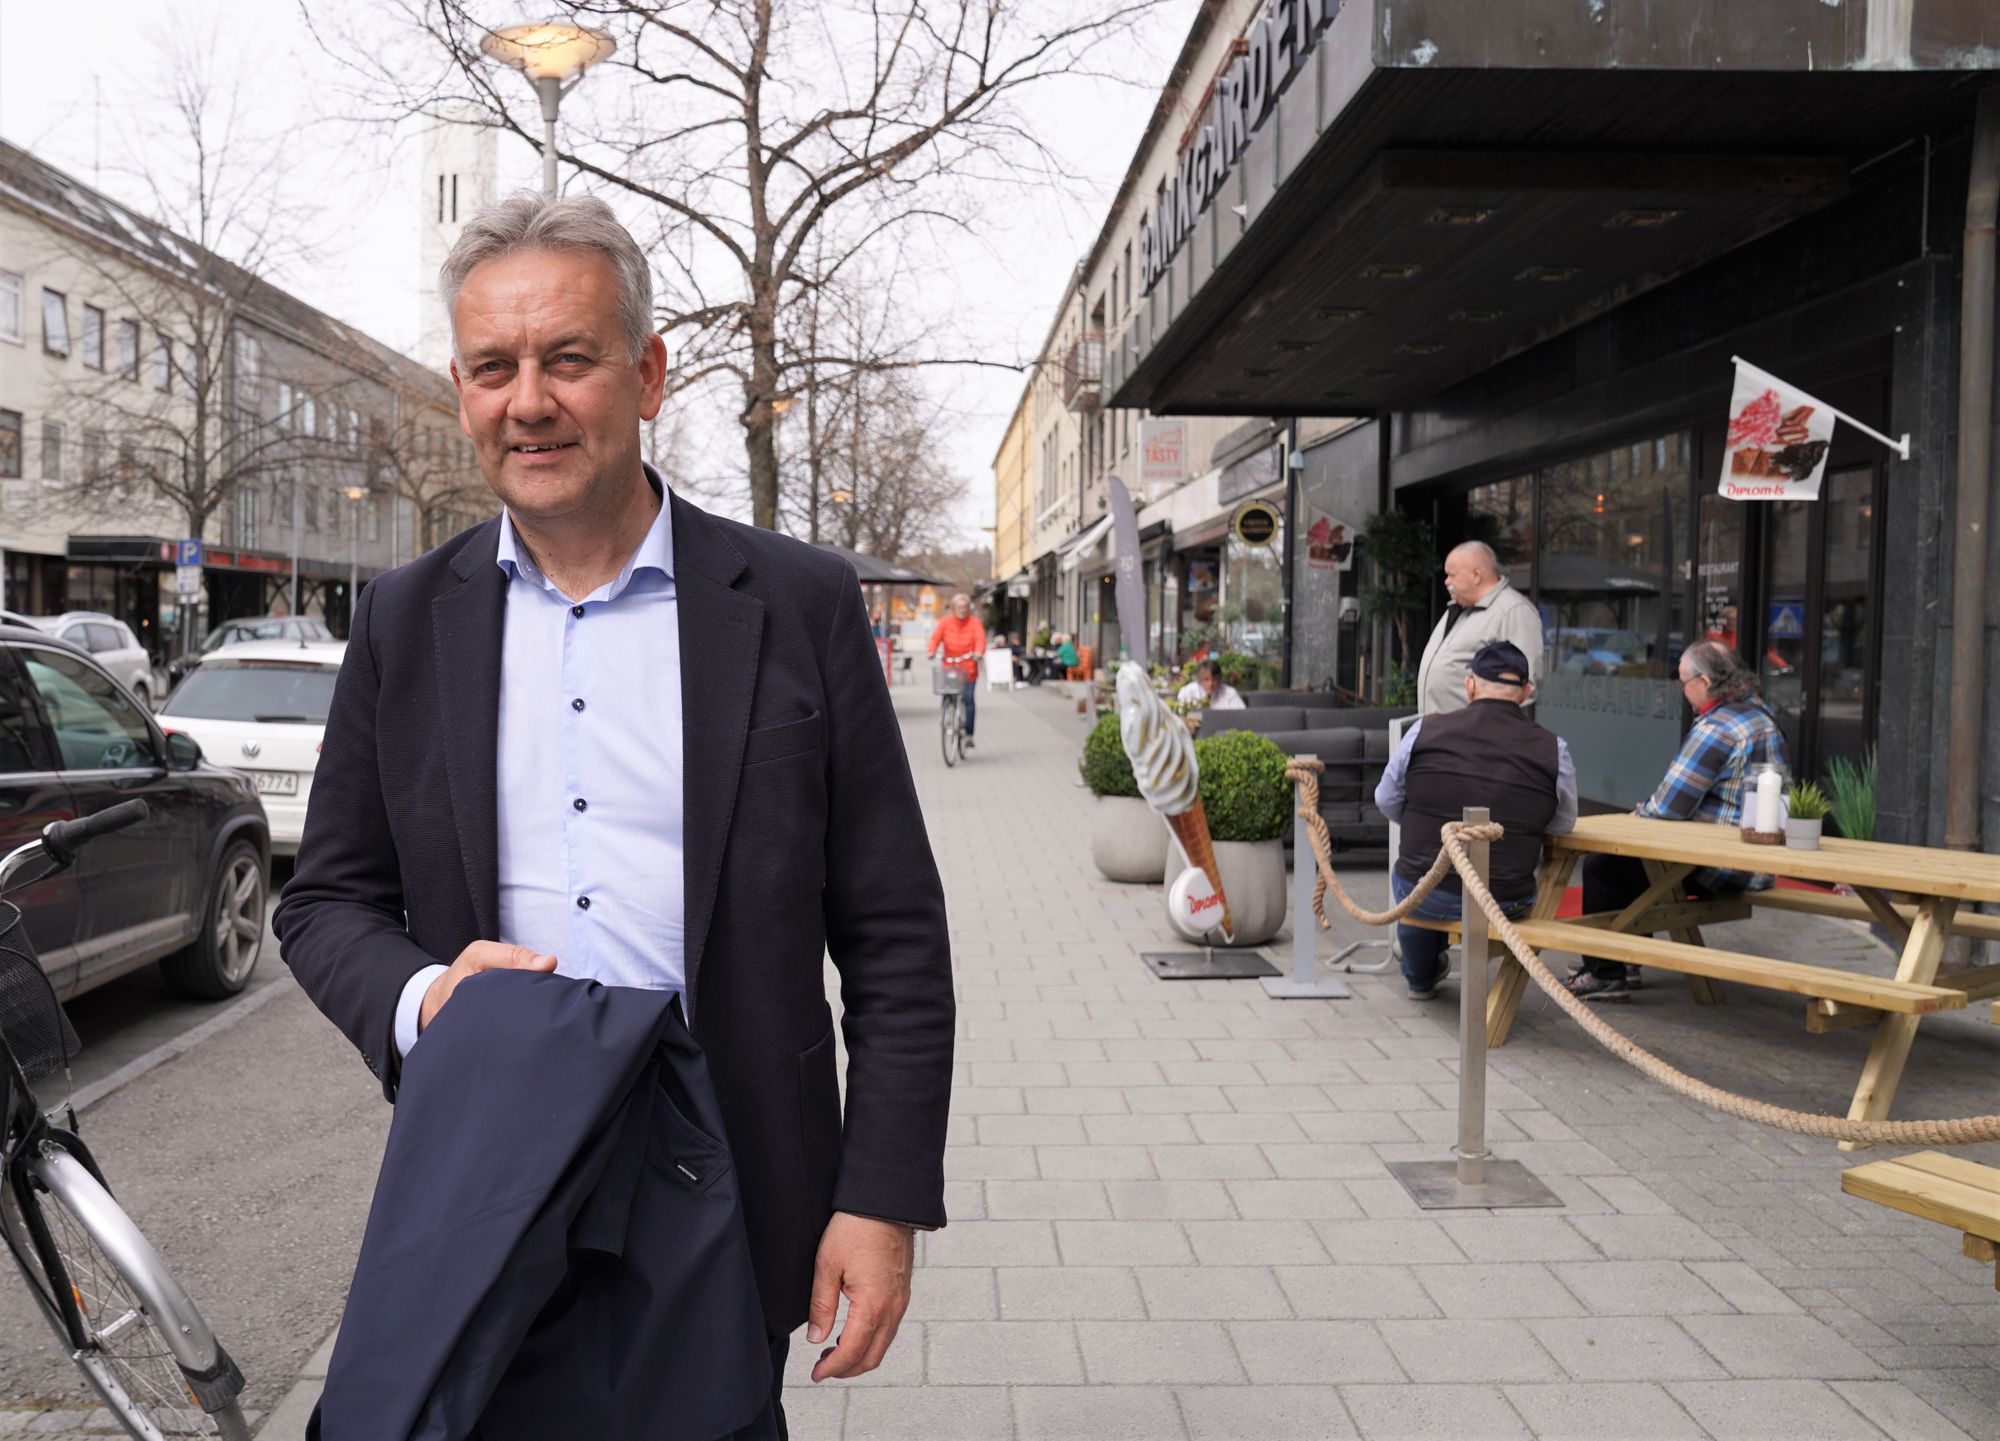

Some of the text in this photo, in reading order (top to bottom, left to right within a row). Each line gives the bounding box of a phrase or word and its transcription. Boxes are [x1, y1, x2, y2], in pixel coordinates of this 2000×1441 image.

[1144, 447, 1179, 464] TASTY
[182, 541, 198, 564] P
[1698, 561, 1739, 576] RESTAURANT
